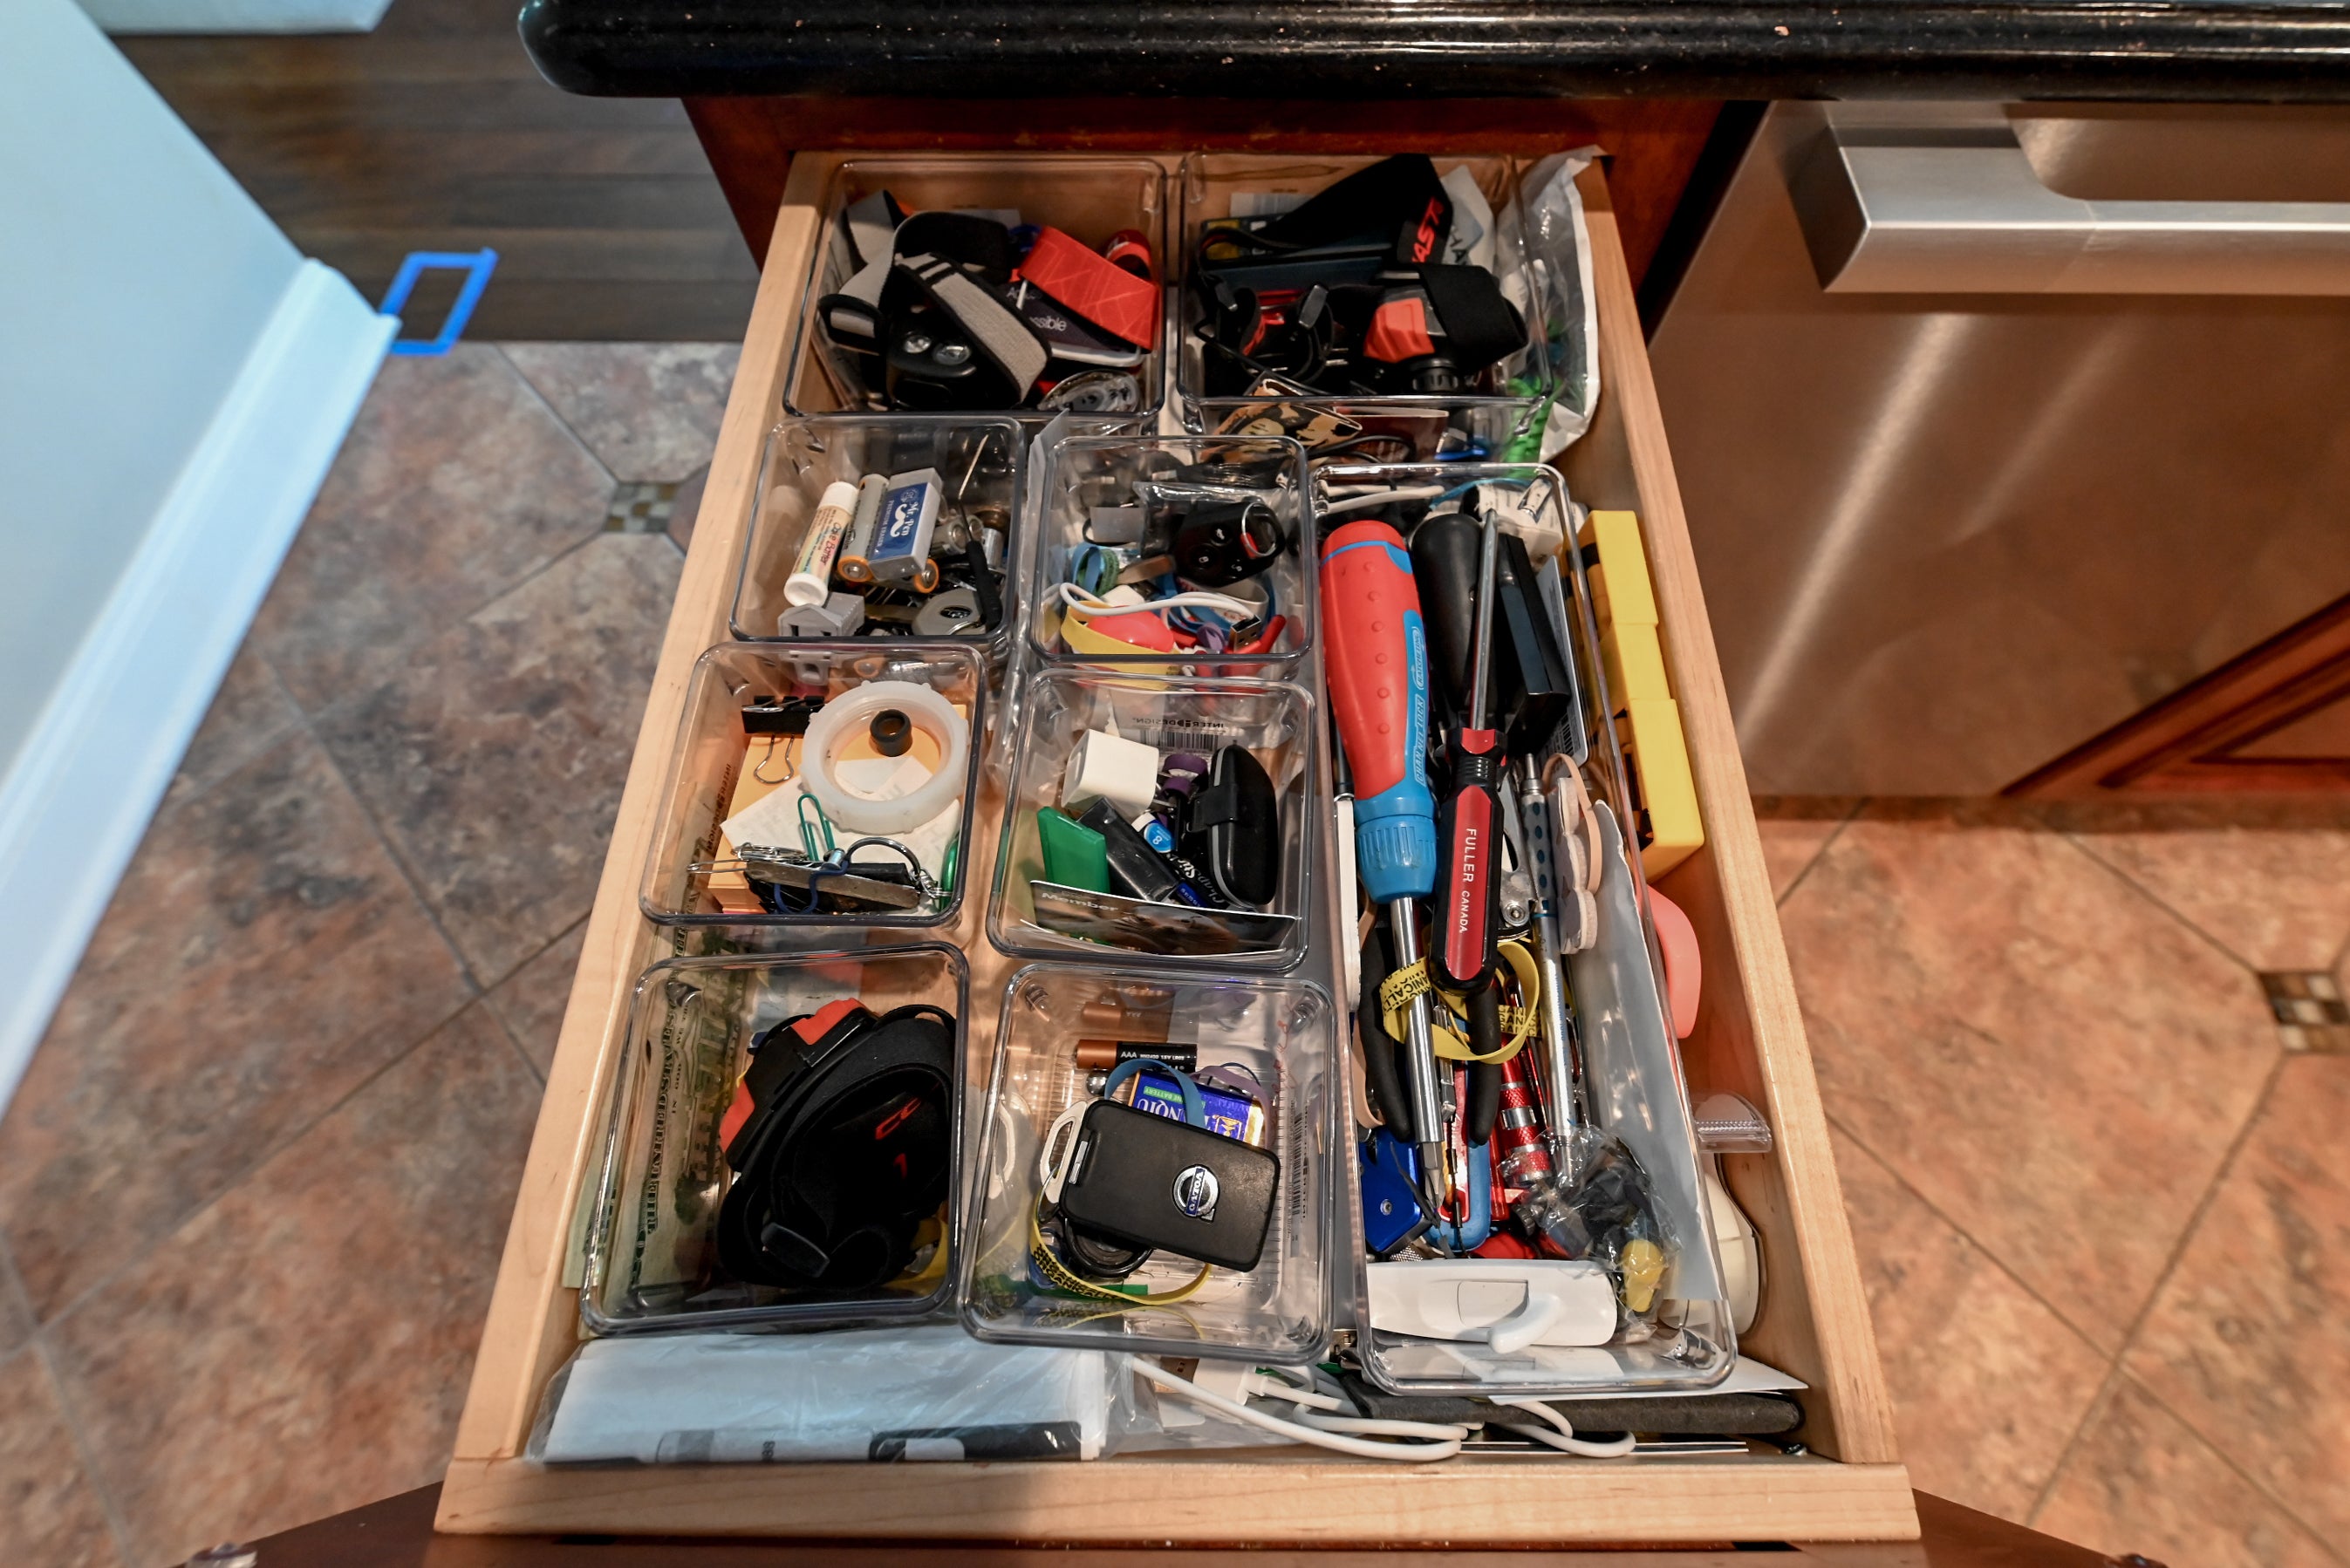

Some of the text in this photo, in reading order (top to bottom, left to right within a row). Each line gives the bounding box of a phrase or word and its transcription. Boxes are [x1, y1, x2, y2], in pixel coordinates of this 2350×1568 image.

[900, 518, 914, 536] Pen
[820, 541, 836, 566] Batter
[1459, 827, 1477, 934] FULLER CANADA
[1042, 891, 1119, 913] Member
[1144, 1087, 1173, 1101] BATTERY
[1188, 1169, 1204, 1213] VOLVO
